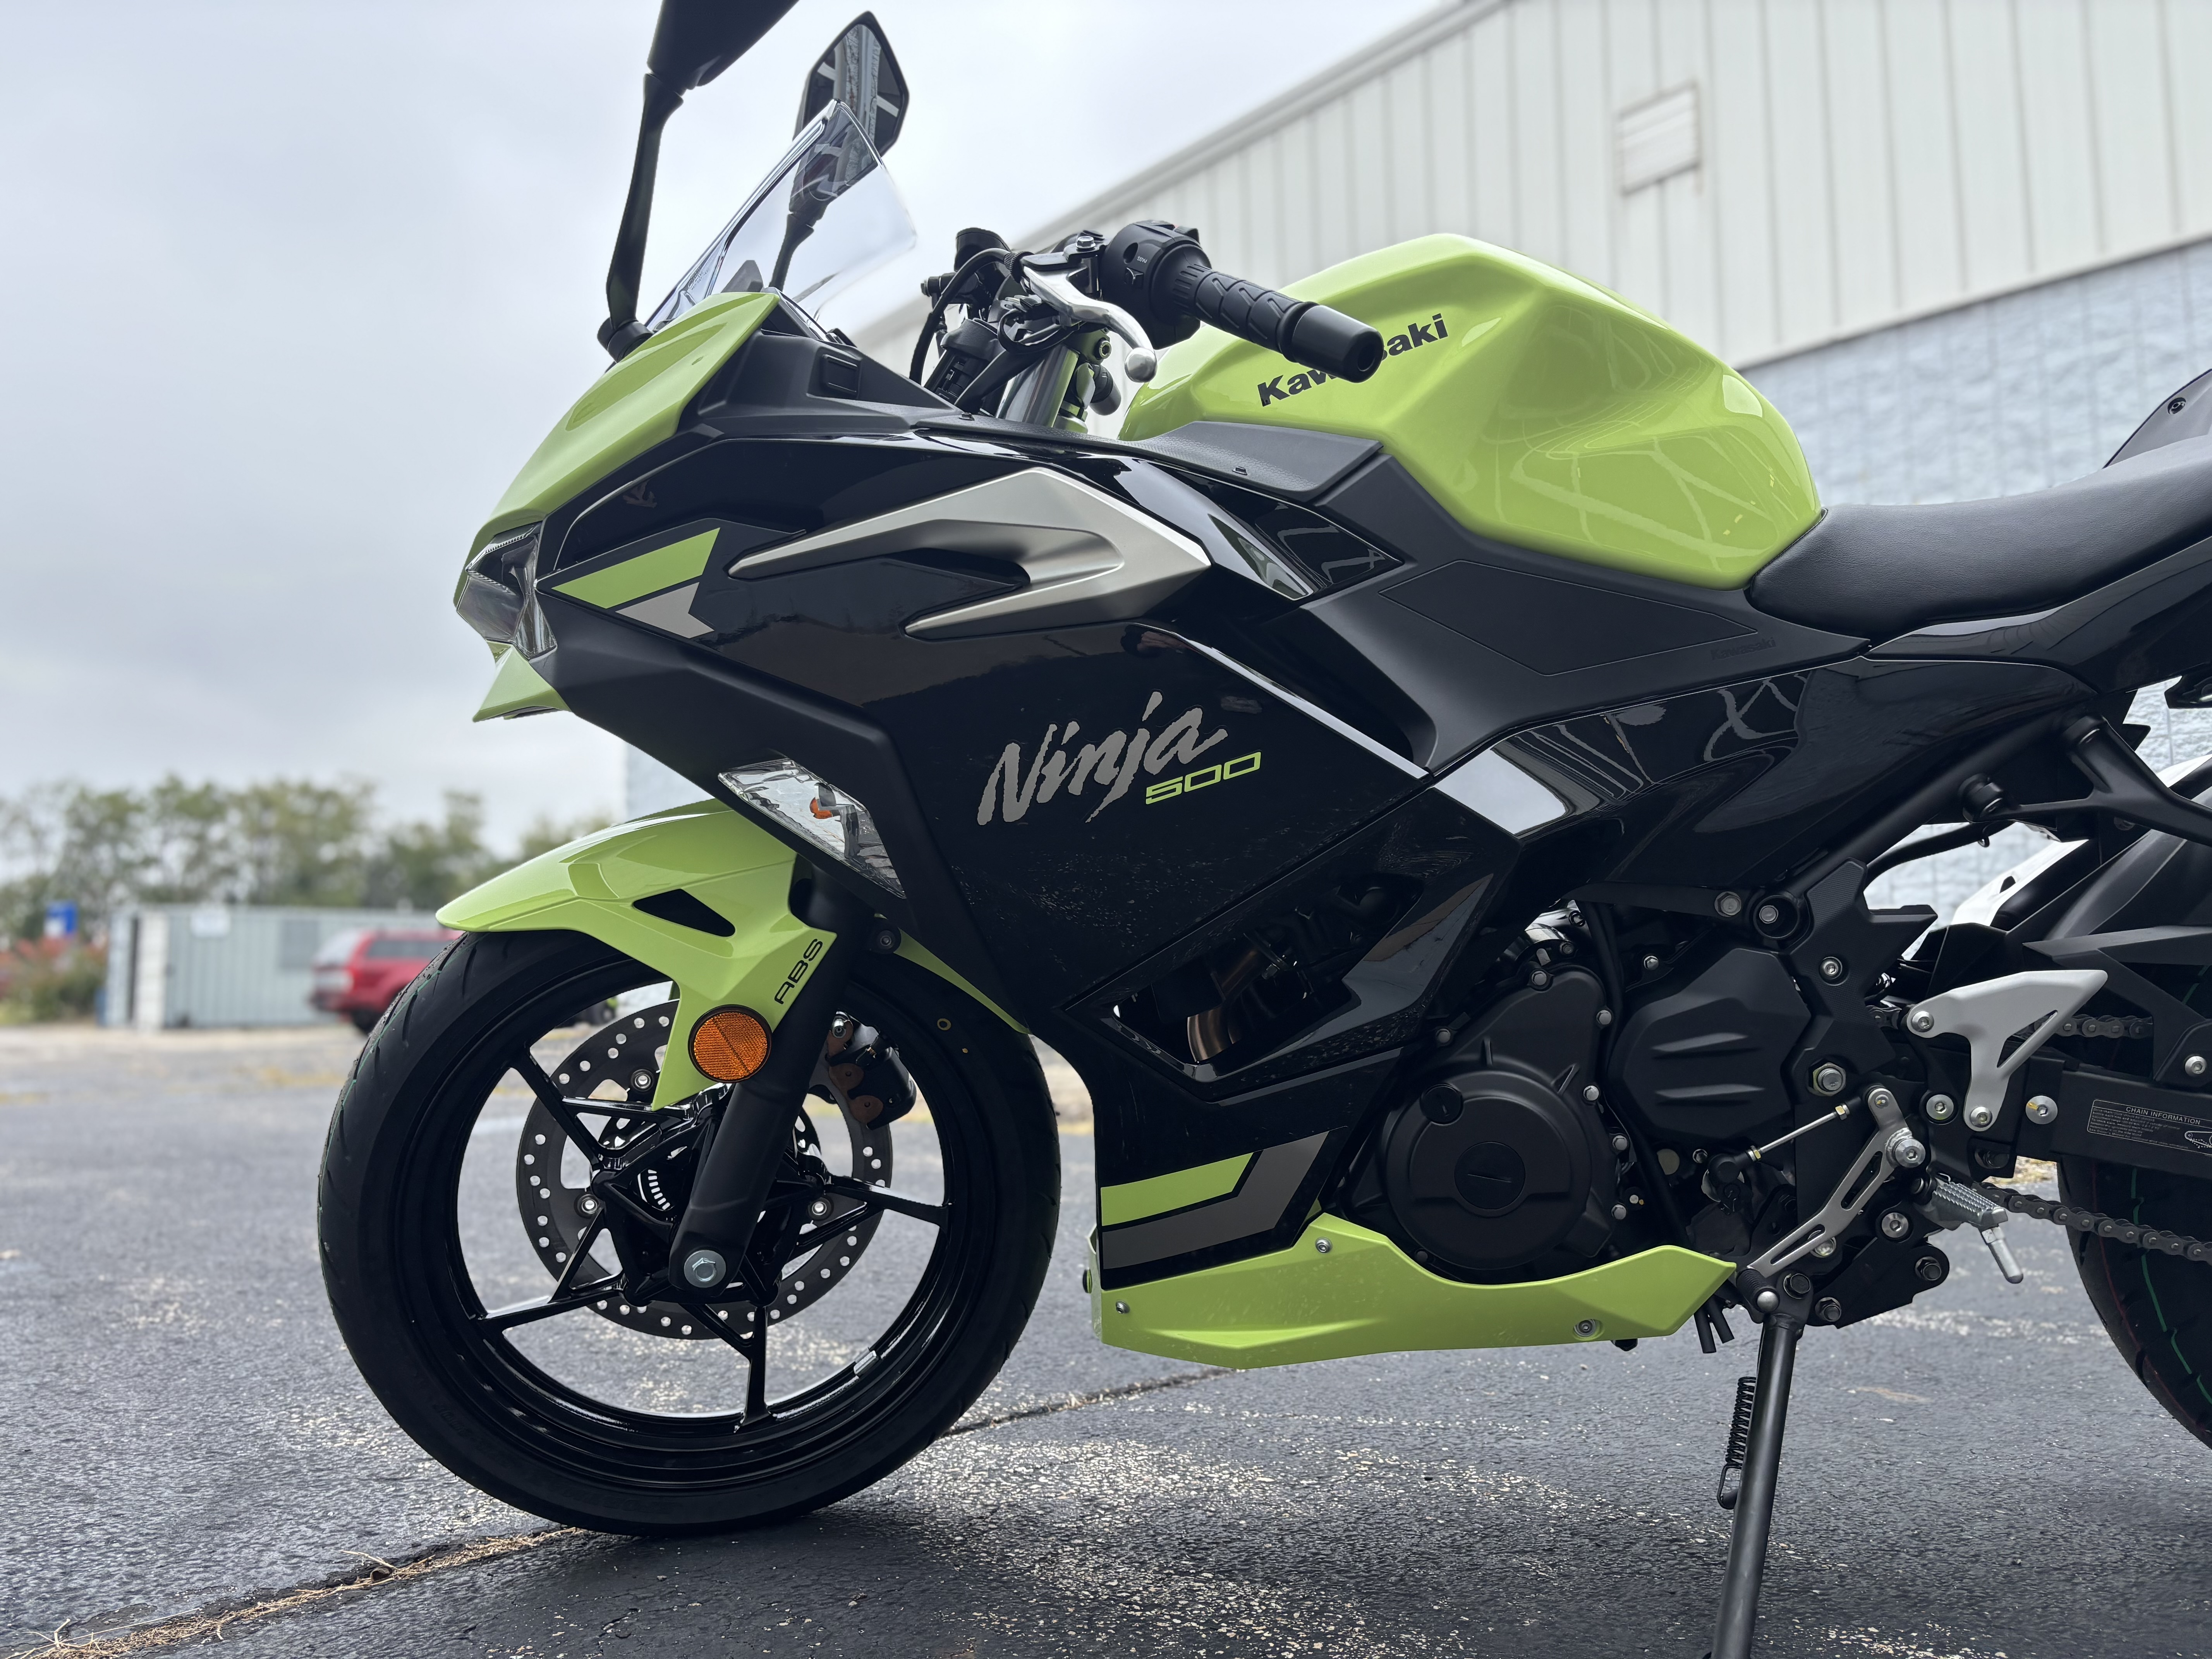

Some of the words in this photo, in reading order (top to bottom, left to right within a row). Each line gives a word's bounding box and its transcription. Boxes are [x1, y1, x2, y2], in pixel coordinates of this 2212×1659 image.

[1257, 313, 1448, 407] Kawaki
[1710, 637, 1776, 660] Kawasaki
[977, 691, 1228, 825] Ninja
[1146, 751, 1261, 805] 500
[774, 938, 823, 1005] ABS
[2126, 1106, 2148, 1115] CHAIN
[2150, 1111, 2201, 1125] INFORMATION
